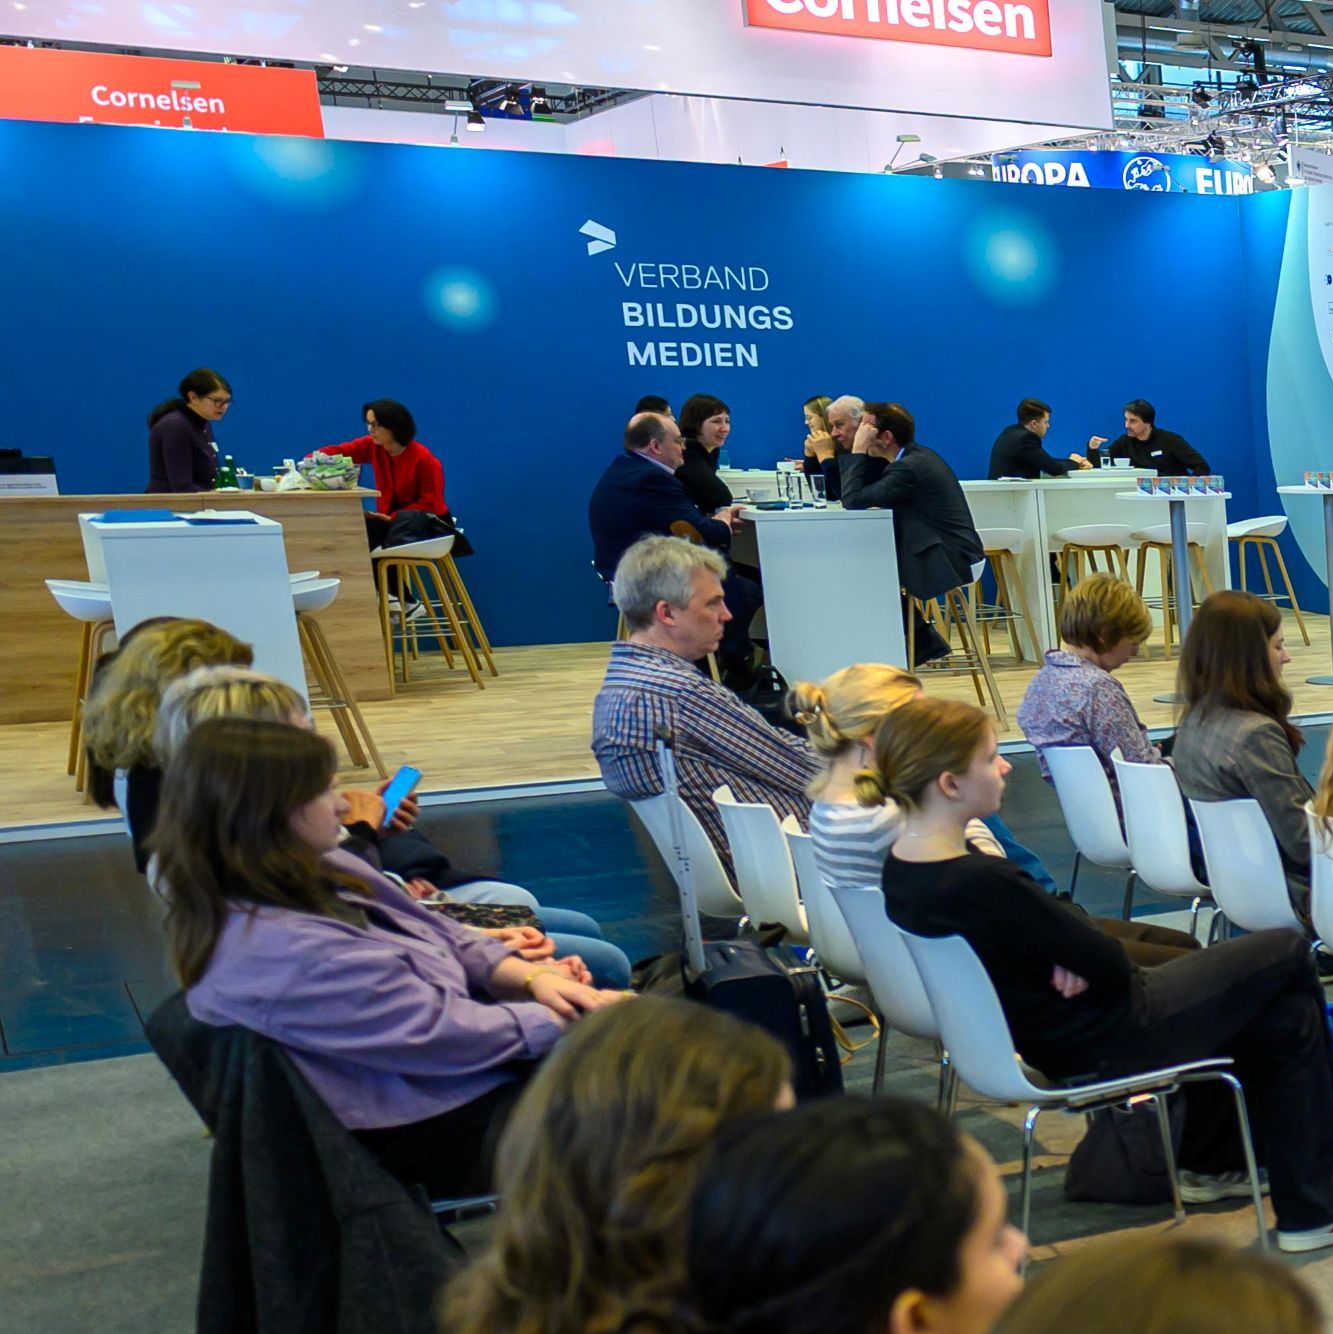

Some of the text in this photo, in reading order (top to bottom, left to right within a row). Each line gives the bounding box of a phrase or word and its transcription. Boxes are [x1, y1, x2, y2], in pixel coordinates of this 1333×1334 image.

[765, 0, 1036, 39] rnelsen
[91, 85, 226, 114] Cornelsen
[614, 262, 769, 291] VERBAND
[622, 302, 794, 330] BILDUNGS
[626, 341, 759, 367] MEDIEN
